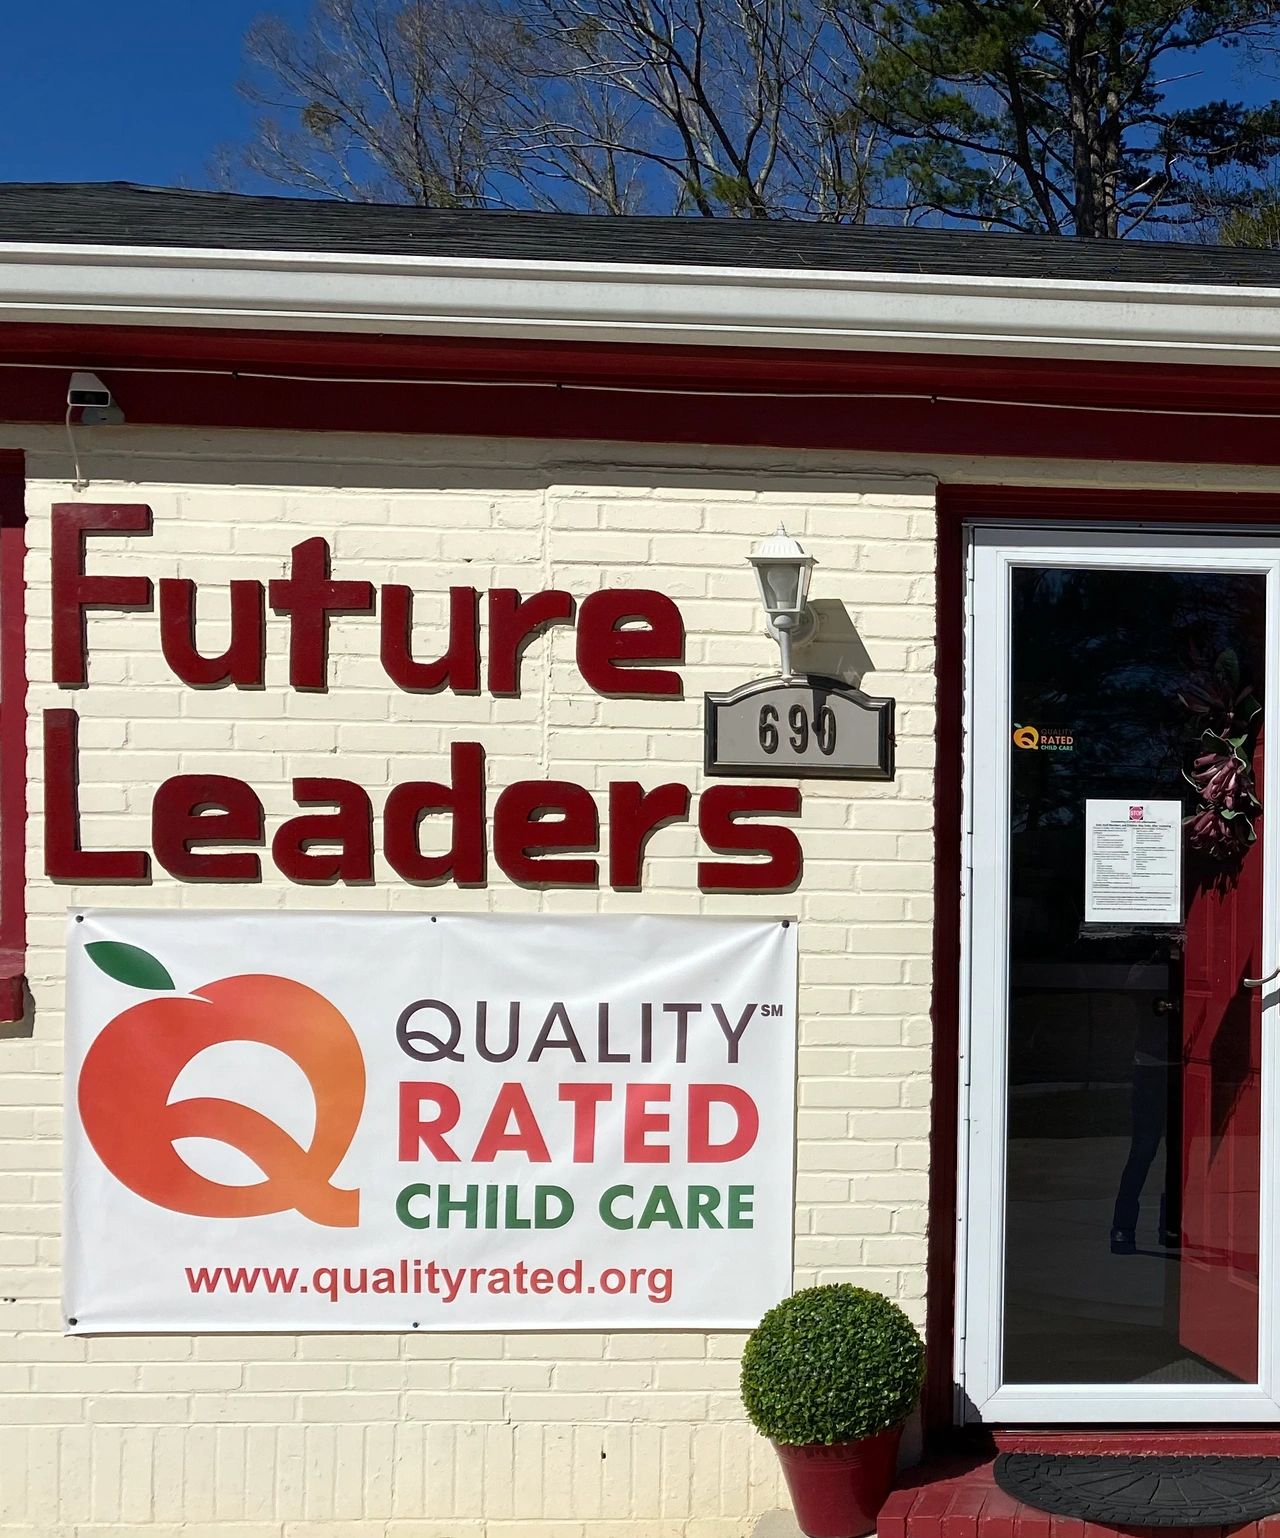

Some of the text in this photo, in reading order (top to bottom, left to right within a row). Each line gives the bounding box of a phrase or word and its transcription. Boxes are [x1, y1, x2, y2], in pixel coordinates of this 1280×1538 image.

[51, 502, 686, 700] Future
[758, 703, 838, 756] 690
[1040, 728, 1074, 736] QUALITY
[1040, 736, 1074, 745] RATED
[42, 707, 804, 894] Leaders
[395, 998, 758, 1064] QUALITY
[399, 1080, 760, 1165] RATED
[395, 1183, 756, 1230] CHILD CARE
[184, 1259, 675, 1304] www.qualityrated.org
